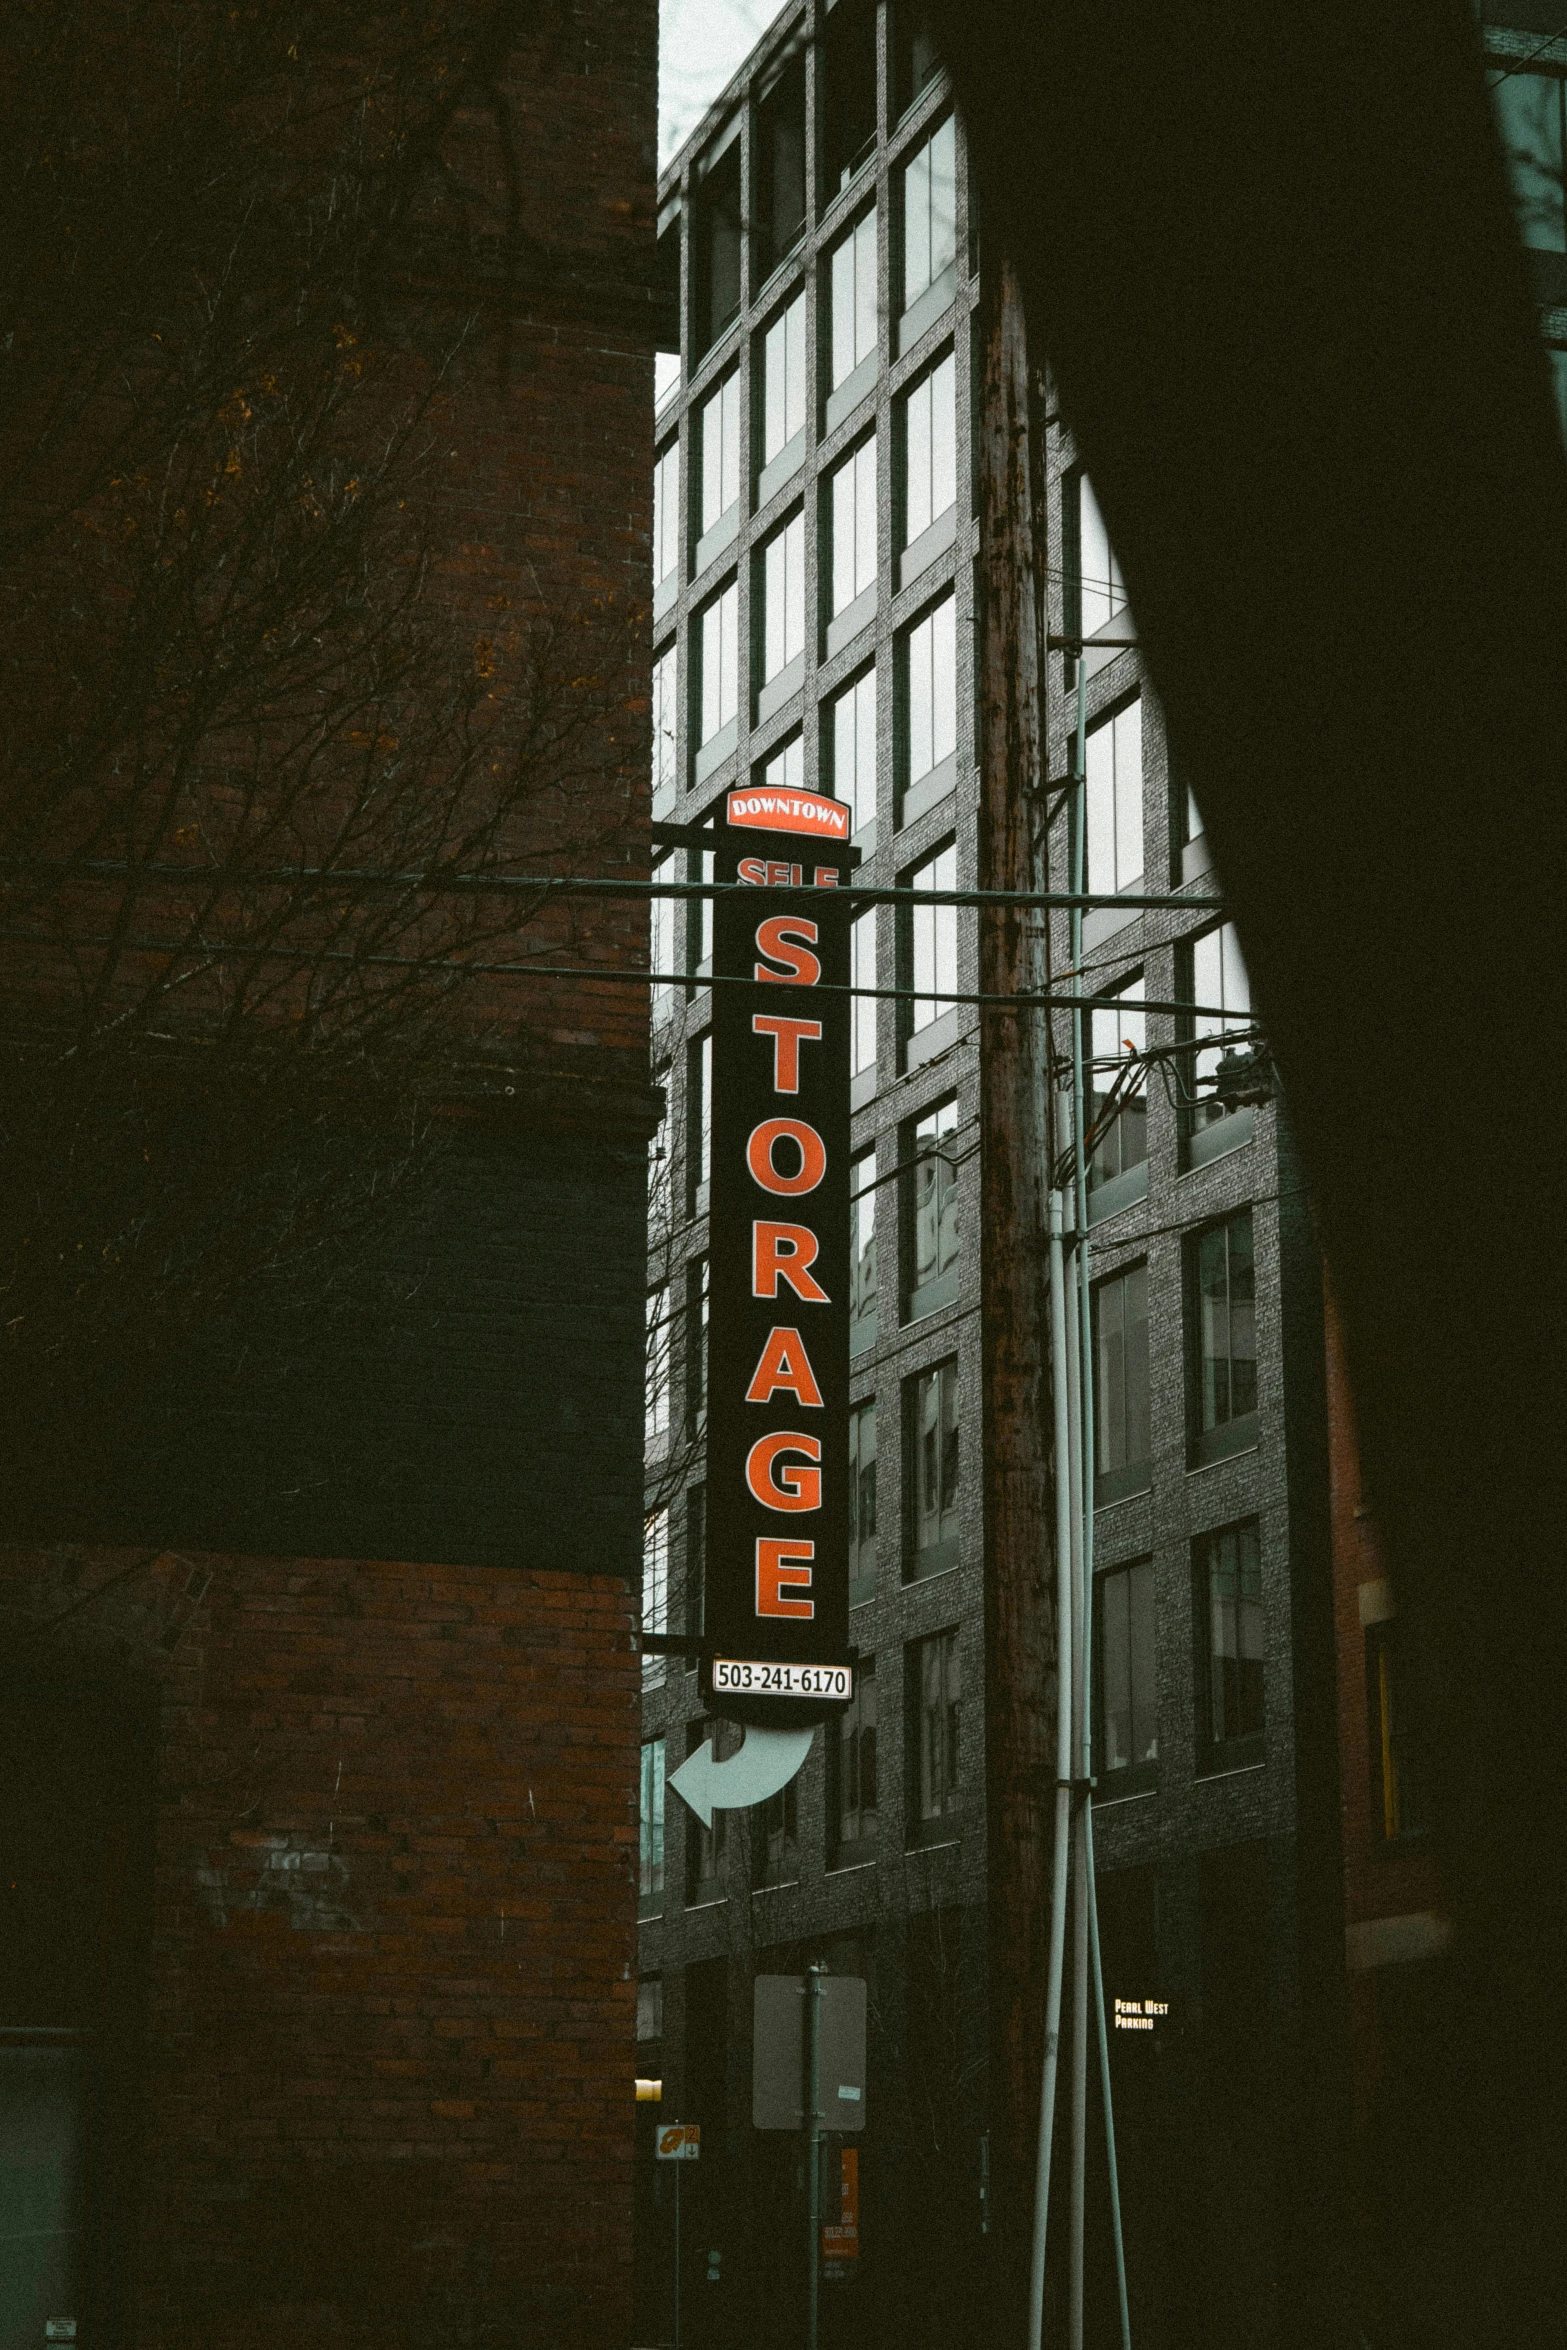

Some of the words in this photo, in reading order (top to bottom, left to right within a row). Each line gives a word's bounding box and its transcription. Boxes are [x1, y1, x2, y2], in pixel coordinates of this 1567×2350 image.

[732, 797, 845, 830] DOWNTOWN
[744, 915, 832, 1620] STORAGE
[718, 1664, 846, 1693] 503-241-6170
